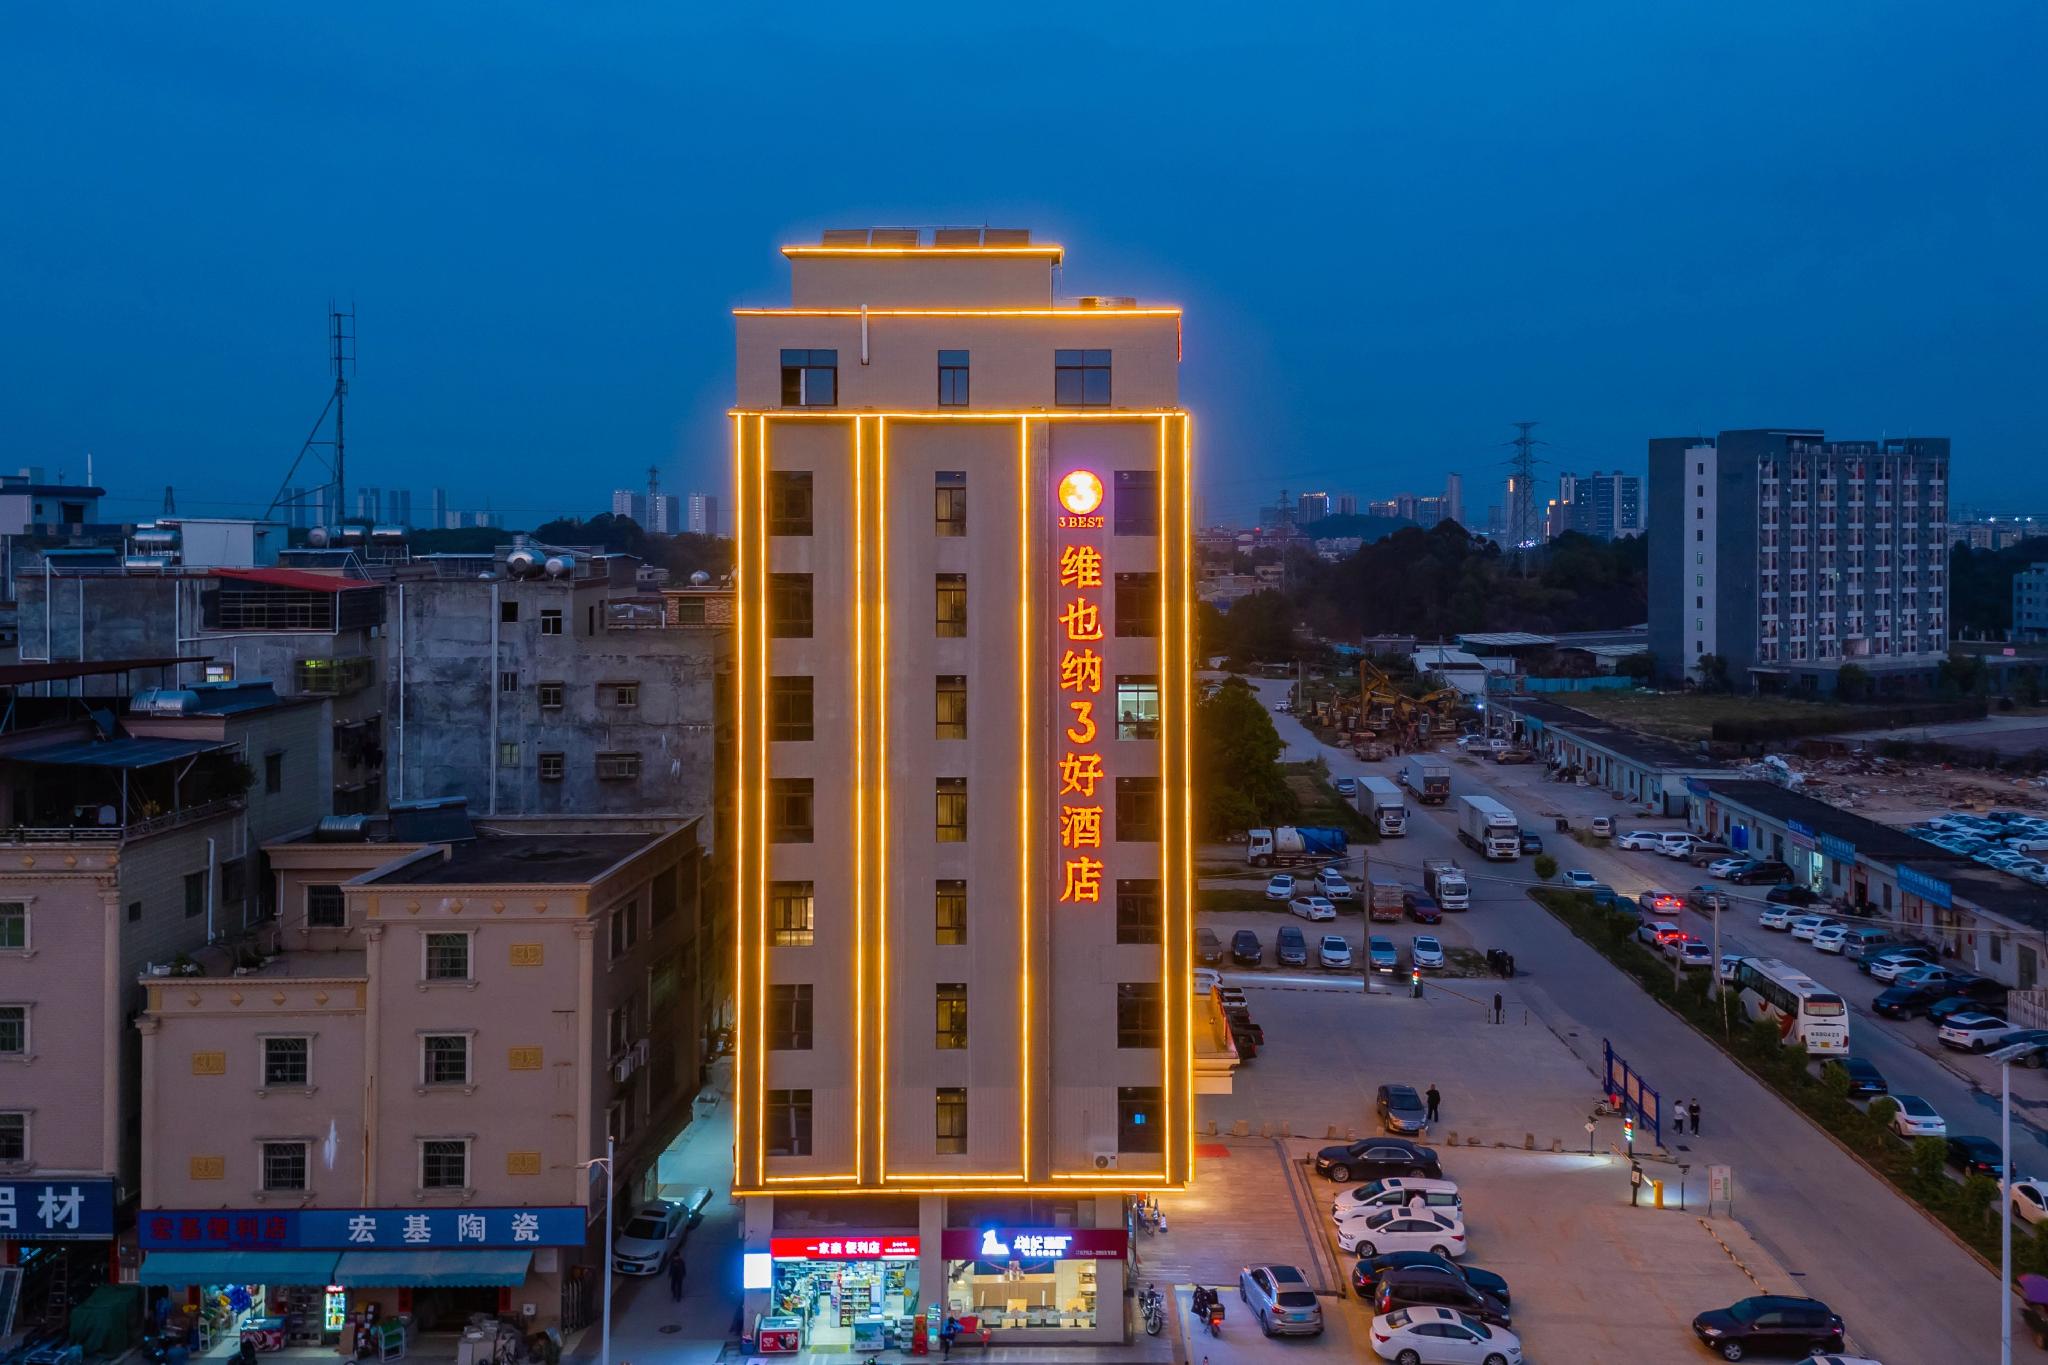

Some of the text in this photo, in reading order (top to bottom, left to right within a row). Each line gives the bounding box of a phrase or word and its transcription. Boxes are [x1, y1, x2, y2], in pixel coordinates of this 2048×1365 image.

[1058, 516, 1104, 528] 3 BEST
[1059, 545, 1104, 902] 维也纳3好酒店
[347, 1212, 541, 1243] 宏基陶瓷
[845, 1241, 880, 1254] 便利店
